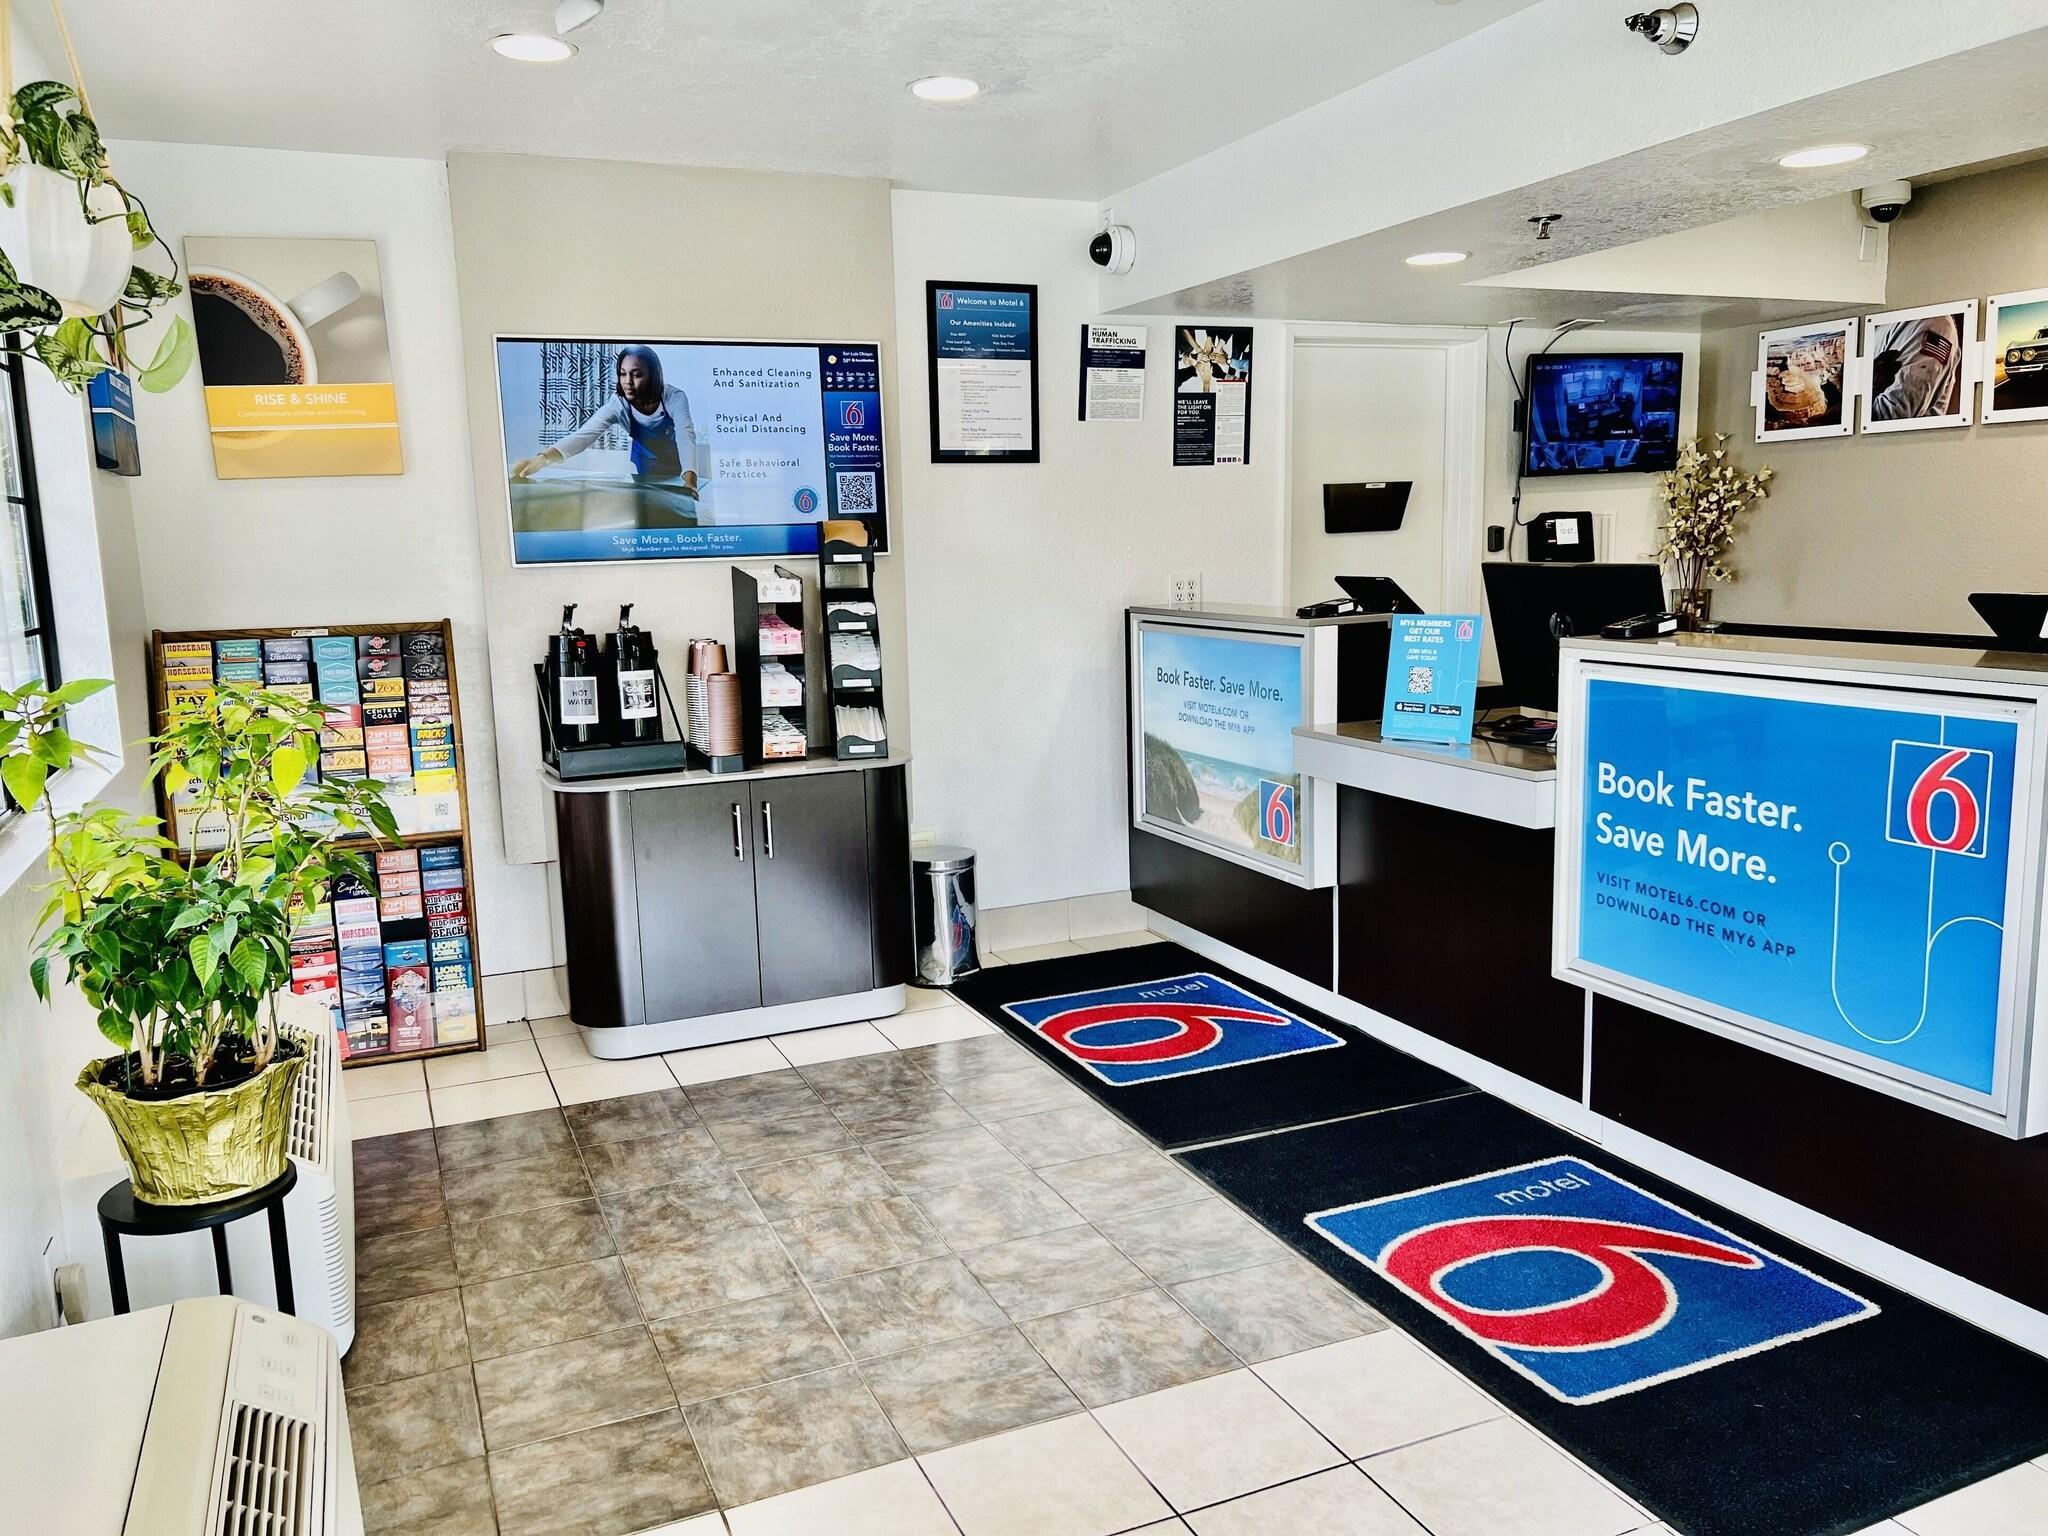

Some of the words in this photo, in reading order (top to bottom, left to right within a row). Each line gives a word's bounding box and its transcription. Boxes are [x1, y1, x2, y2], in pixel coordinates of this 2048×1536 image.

[956, 297, 988, 305] Welcome
[994, 320, 1017, 328] Include:
[1092, 337, 1137, 345] TRAFFICKING
[712, 367, 763, 377] Enhanced
[767, 368, 812, 379] Cleaning
[713, 379, 734, 388] And
[738, 379, 800, 388] Sanitization
[255, 393, 286, 405] RISE
[290, 393, 301, 405] &
[305, 392, 349, 405] SHINE
[716, 413, 758, 424] Physical
[762, 413, 782, 422] And
[845, 400, 863, 425] 6
[716, 424, 748, 433] Social
[752, 424, 806, 435] Distancing
[829, 433, 850, 441] Save
[852, 432, 878, 441] More.
[828, 443, 851, 452] Book
[852, 443, 881, 452] Faster.
[719, 459, 742, 468] Safe
[745, 458, 800, 467] Behavioral
[720, 470, 767, 478] Practices
[612, 535, 638, 545] Save
[641, 535, 673, 544] More.
[677, 533, 704, 543] Book
[707, 533, 742, 543] Faster.
[1416, 619, 1452, 628] MEMBERS
[1408, 627, 1423, 635] GET
[1424, 627, 1441, 635] OUR
[1404, 635, 1421, 643] BEST
[1422, 635, 1444, 644] RATES
[167, 643, 211, 652] HORSEBACK
[167, 667, 212, 676] HORSEBACK
[1157, 667, 1180, 686] Book
[1183, 671, 1216, 691] Faster.
[1219, 676, 1245, 696] Save
[1249, 680, 1283, 702] More.
[567, 698, 593, 706] WATER
[1183, 700, 1196, 710] VISIT
[1198, 702, 1238, 719] MOTEL6.COM
[1239, 711, 1249, 720] OR
[1178, 712, 1213, 727] DOWNLOAD
[1214, 719, 1226, 730] THE
[1227, 721, 1241, 733] MY6
[1242, 724, 1256, 735] APP
[417, 728, 447, 740] BRICKS
[420, 751, 450, 762] BRICKS
[1598, 761, 1675, 808] Book
[1686, 777, 1803, 832] Faster.
[1906, 749, 1980, 853] 6
[1266, 784, 1292, 845] 6
[1595, 812, 1665, 857] Save
[1676, 828, 1777, 884] More.
[1596, 871, 1630, 891] VISIT
[1635, 881, 1736, 920] MOTEL6.COM
[1742, 910, 1767, 927] OR
[428, 902, 460, 915] BEACH
[1596, 892, 1681, 927] DOWNLOAD
[1686, 916, 1715, 937] THE
[1721, 927, 1756, 948] MY6
[1762, 939, 1796, 957] APP
[341, 927, 379, 939] HORSEBACK
[433, 925, 465, 938] BEACH
[1139, 979, 1209, 1001] motel
[1035, 1002, 1292, 1065] 6
[1494, 1172, 1591, 1206] motel
[1376, 1214, 1765, 1353] 6
